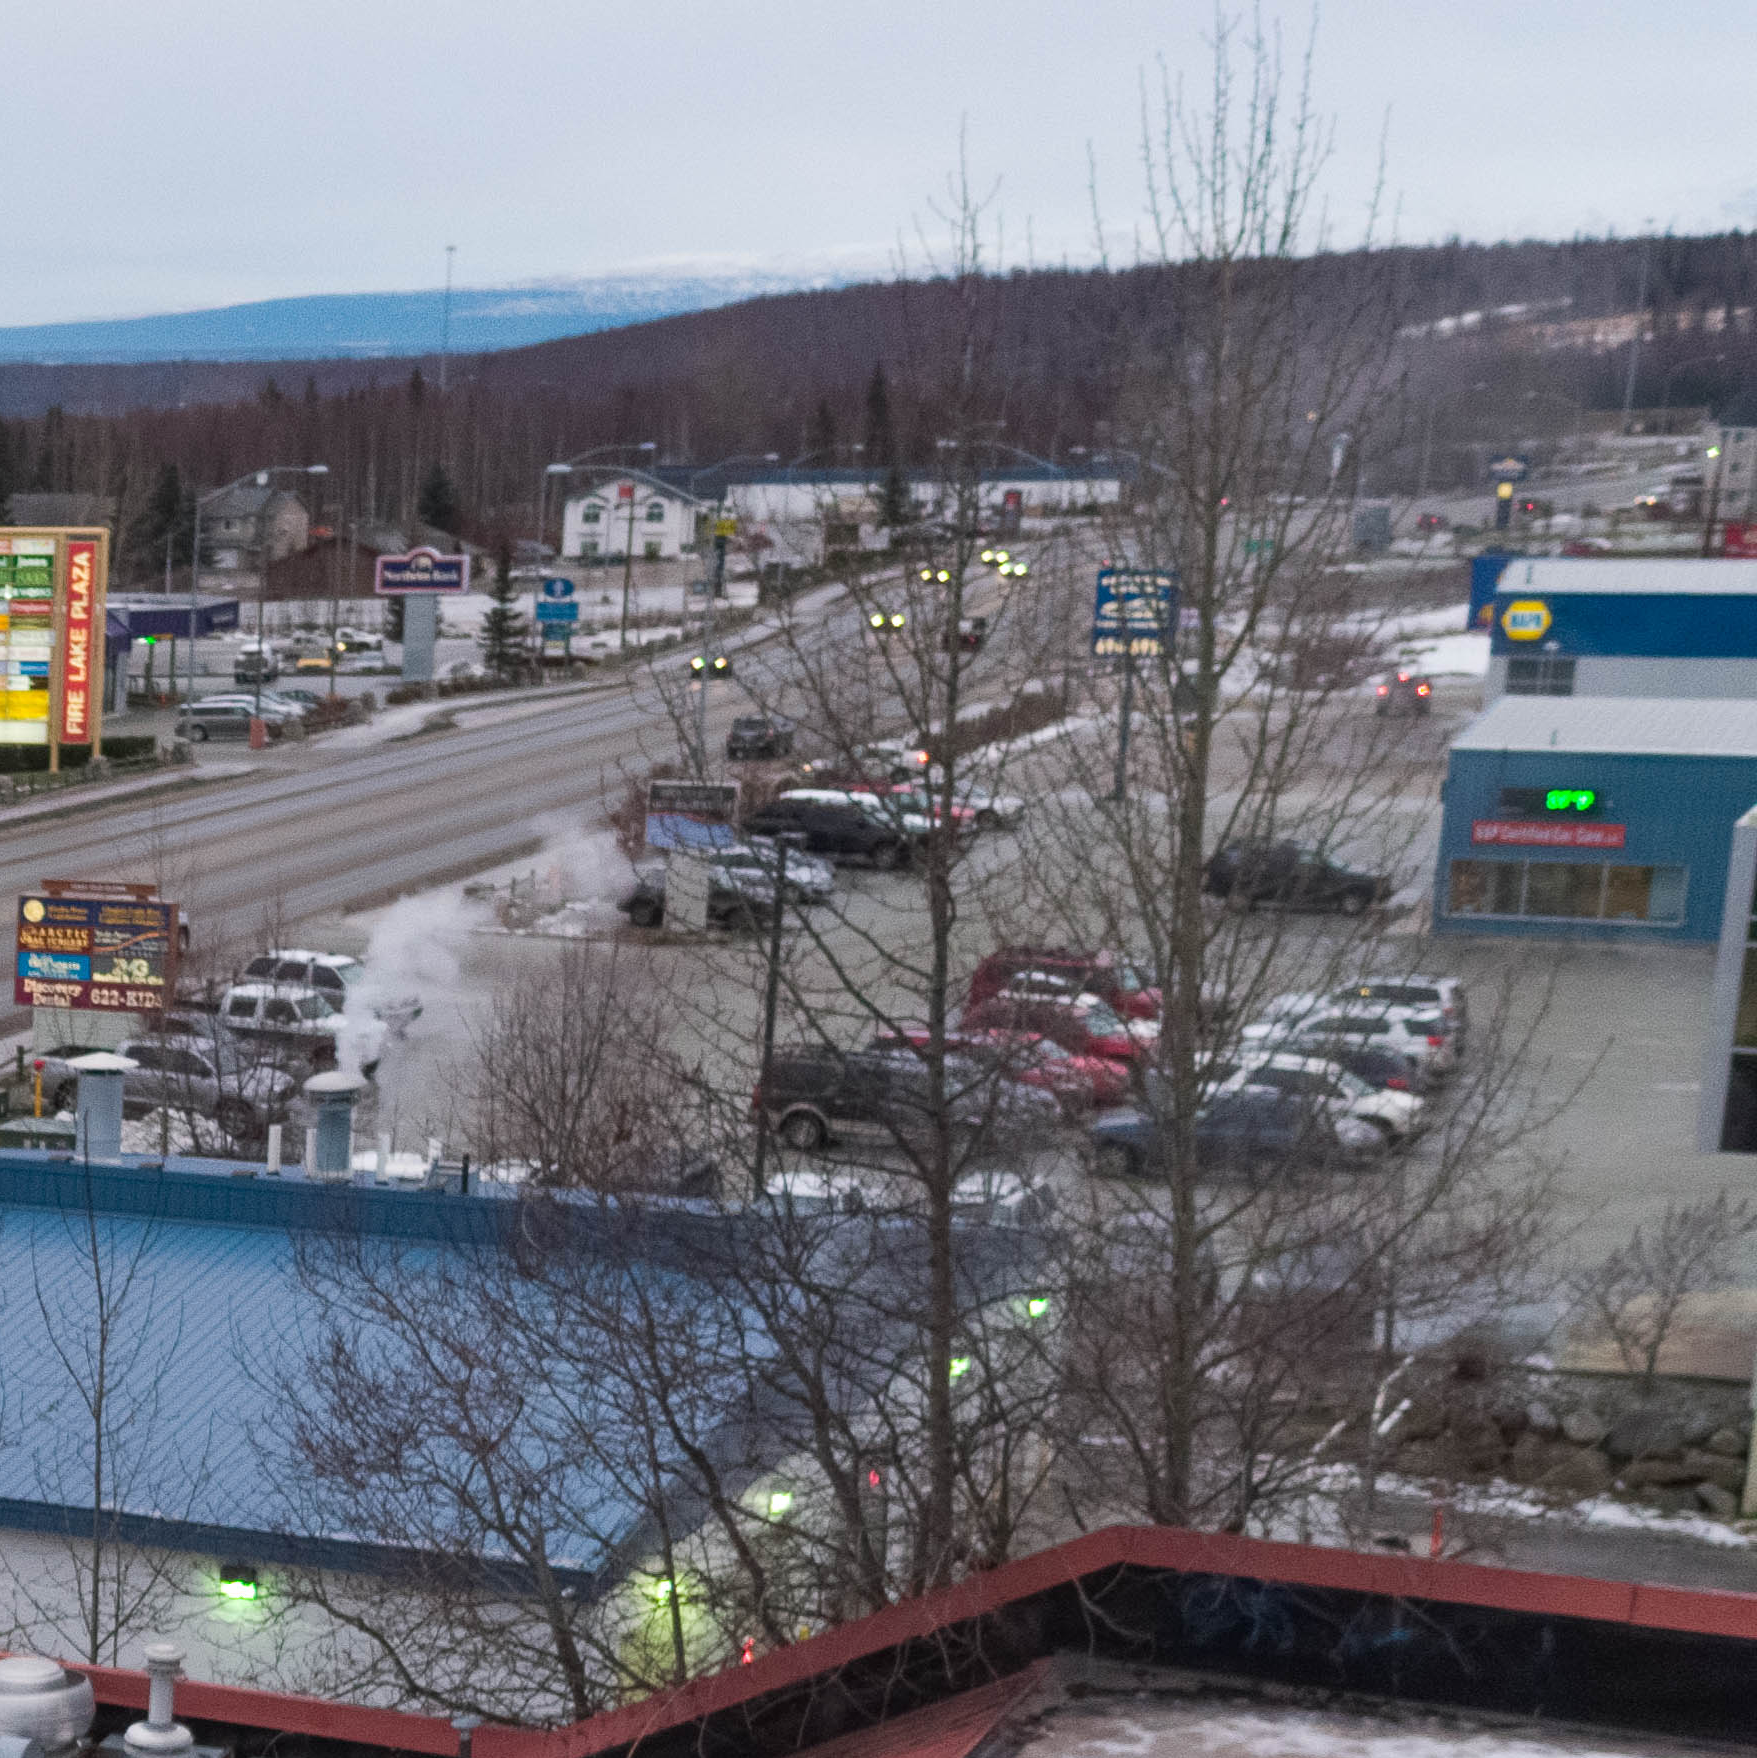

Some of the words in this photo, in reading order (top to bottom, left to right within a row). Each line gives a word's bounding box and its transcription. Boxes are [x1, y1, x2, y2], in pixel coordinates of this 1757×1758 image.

[70, 551, 91, 619] PLAZA
[68, 627, 87, 681] LAKE
[66, 690, 85, 735] FIRE
